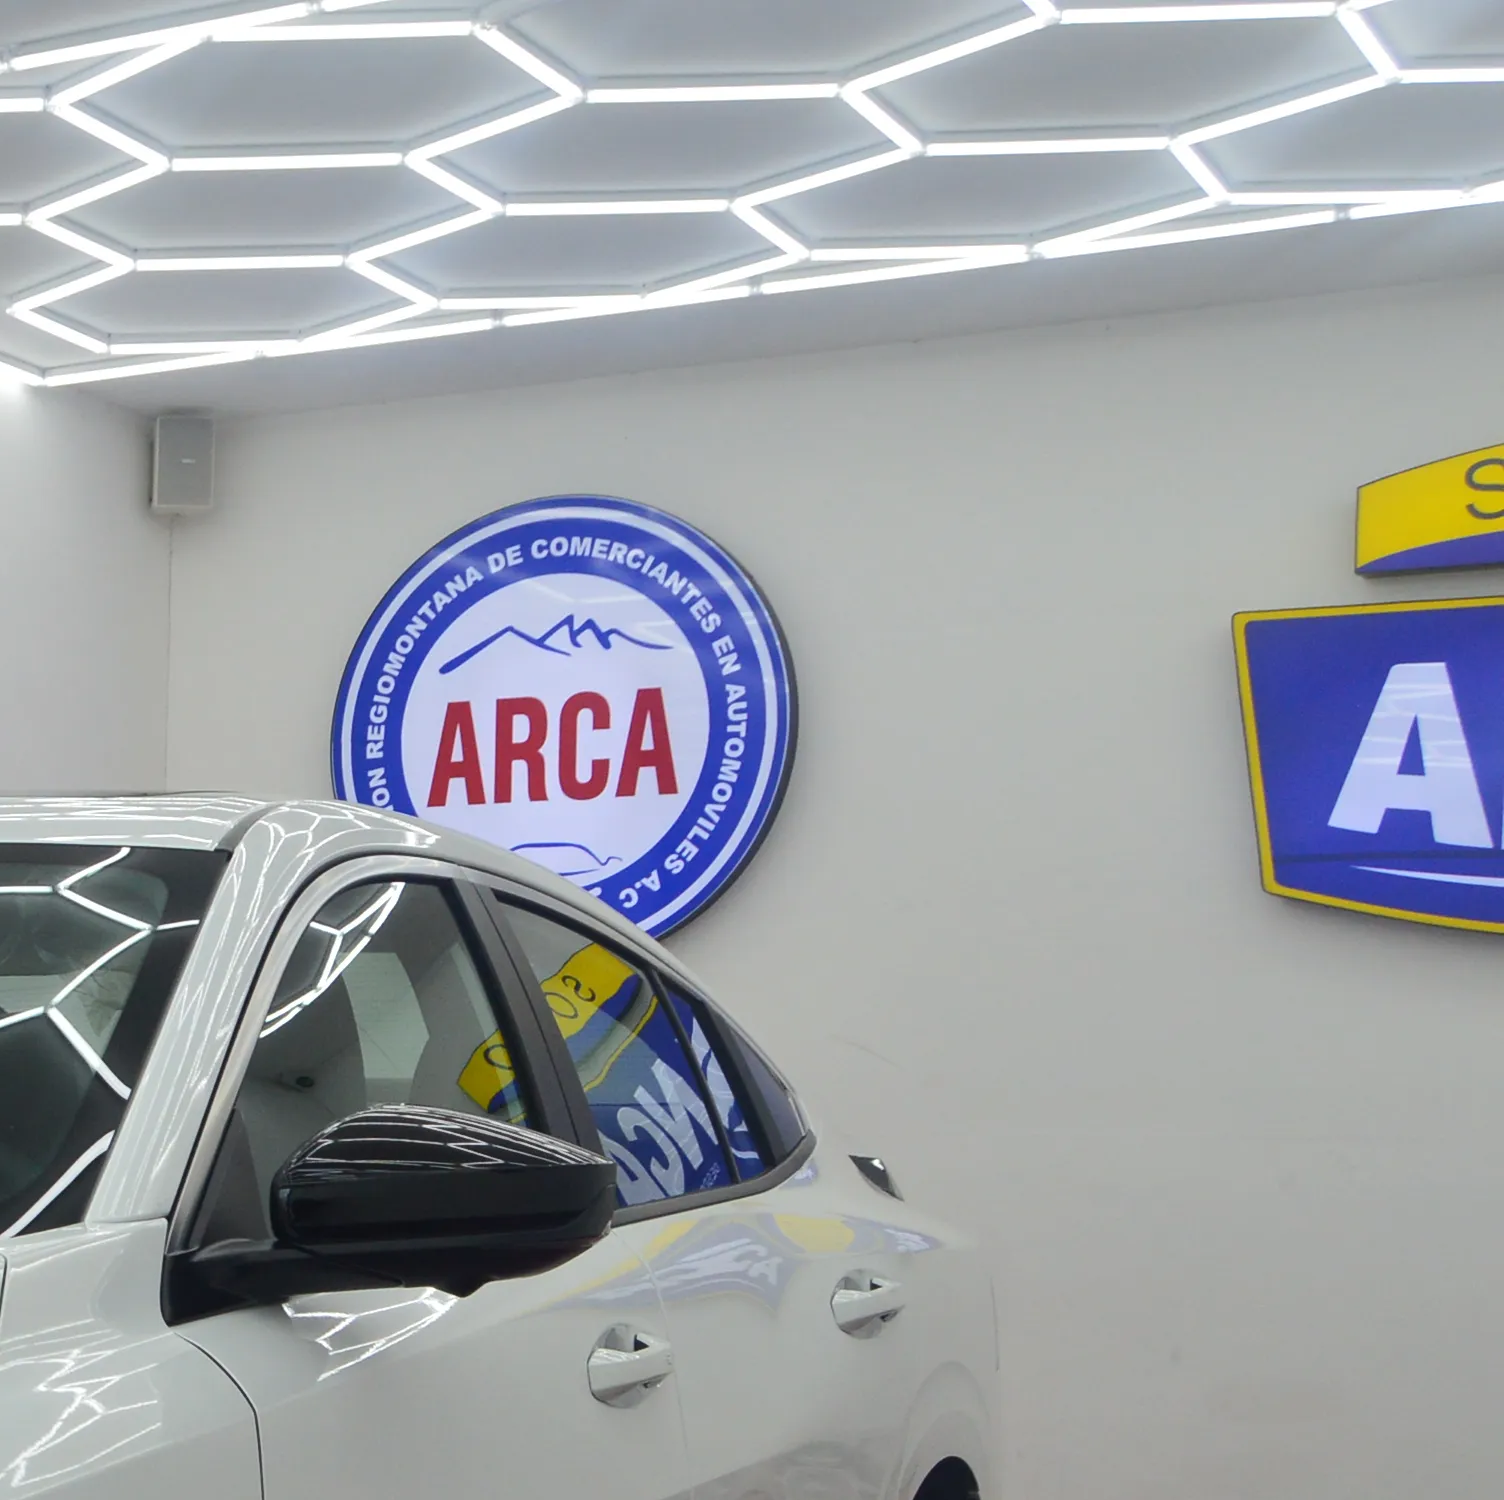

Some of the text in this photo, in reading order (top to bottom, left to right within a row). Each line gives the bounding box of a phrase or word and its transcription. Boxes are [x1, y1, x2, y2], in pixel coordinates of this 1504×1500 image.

[486, 544, 525, 574] DE
[530, 535, 722, 634] COMERCIANTES
[366, 565, 485, 760] REGIOMONTANA
[711, 634, 742, 676] EN
[426, 686, 679, 808] ARCA
[664, 683, 749, 876] AUTOMOVILES
